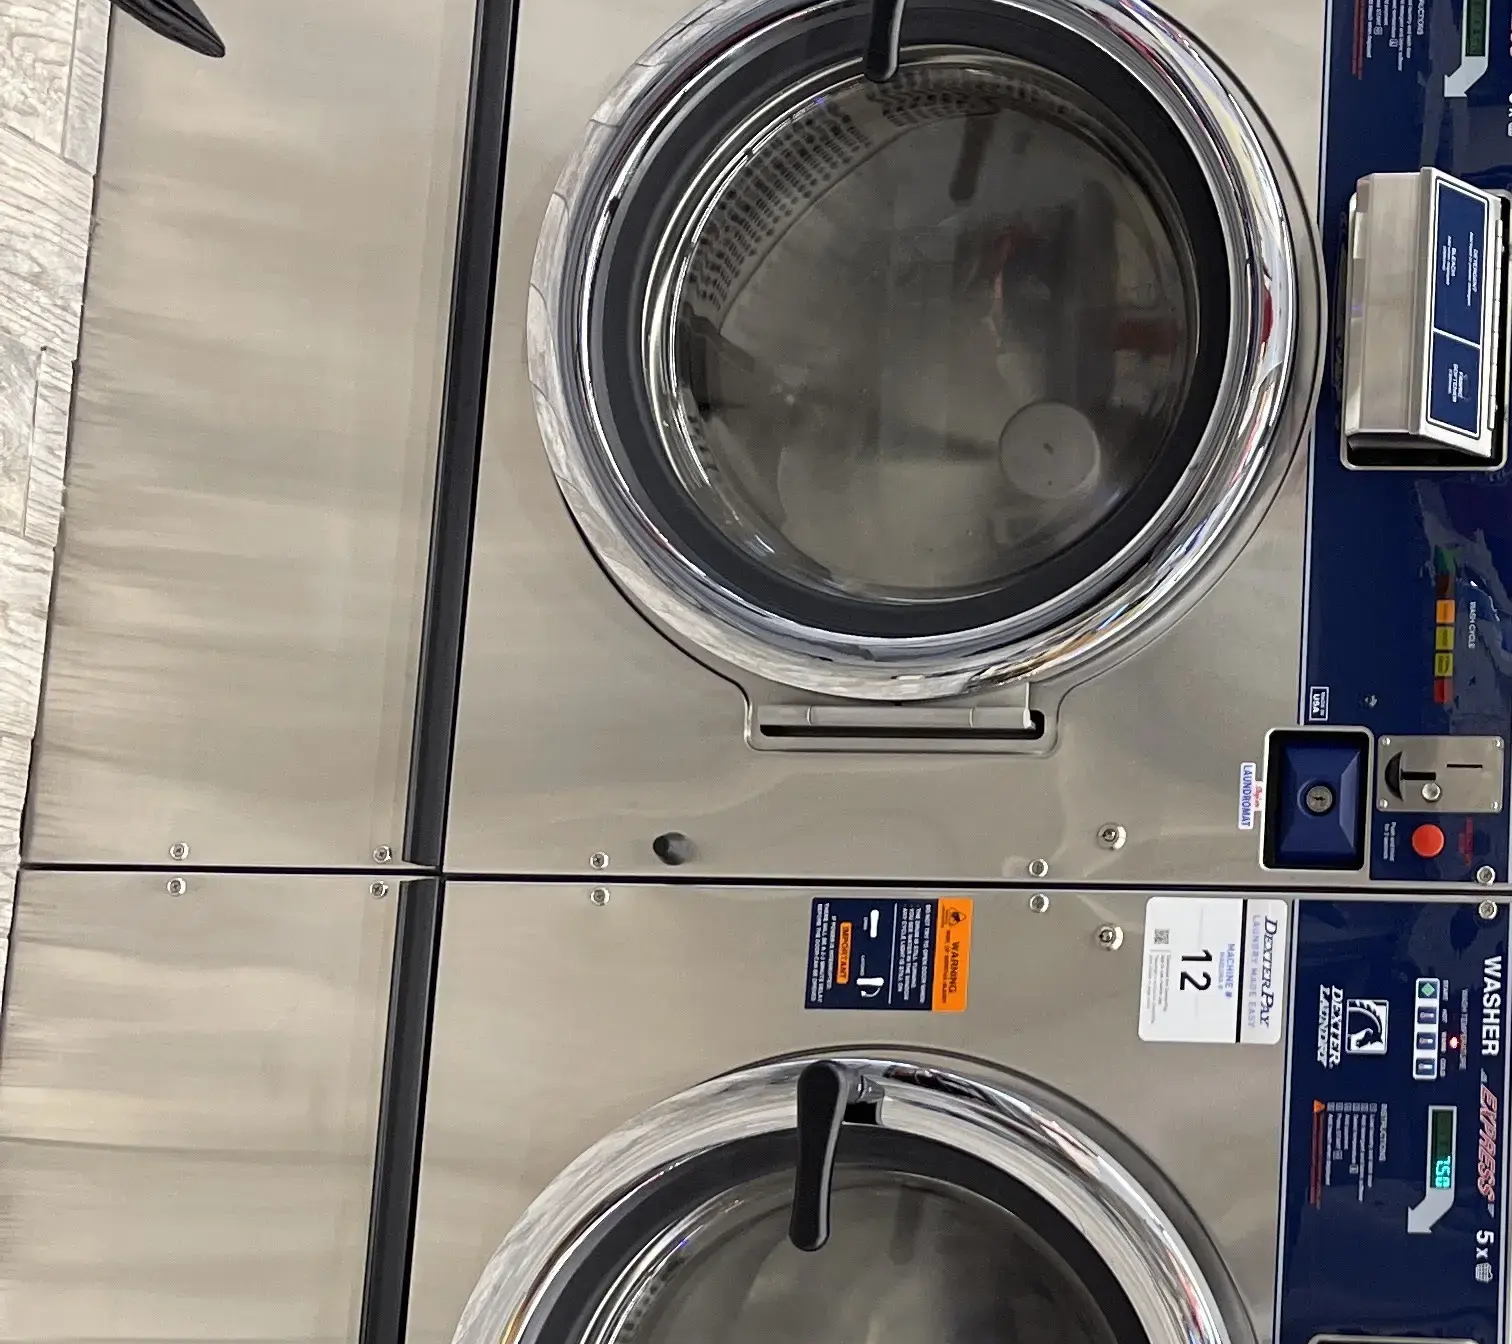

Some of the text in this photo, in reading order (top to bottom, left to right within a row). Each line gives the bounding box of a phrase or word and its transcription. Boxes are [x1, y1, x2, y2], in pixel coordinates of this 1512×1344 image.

[1468, 625, 1476, 648] CYCLE
[1312, 694, 1320, 712] USA
[1241, 765, 1253, 826] LAUNDROMAT
[839, 927, 849, 979] IMPORTANT
[949, 941, 960, 993] WARNING
[1180, 949, 1212, 991] 12
[1316, 984, 1330, 1068] LAUNDRY
[1329, 985, 1343, 1067] DEXTER
[1476, 956, 1501, 1259] WASHER EXPRESS 5 x
